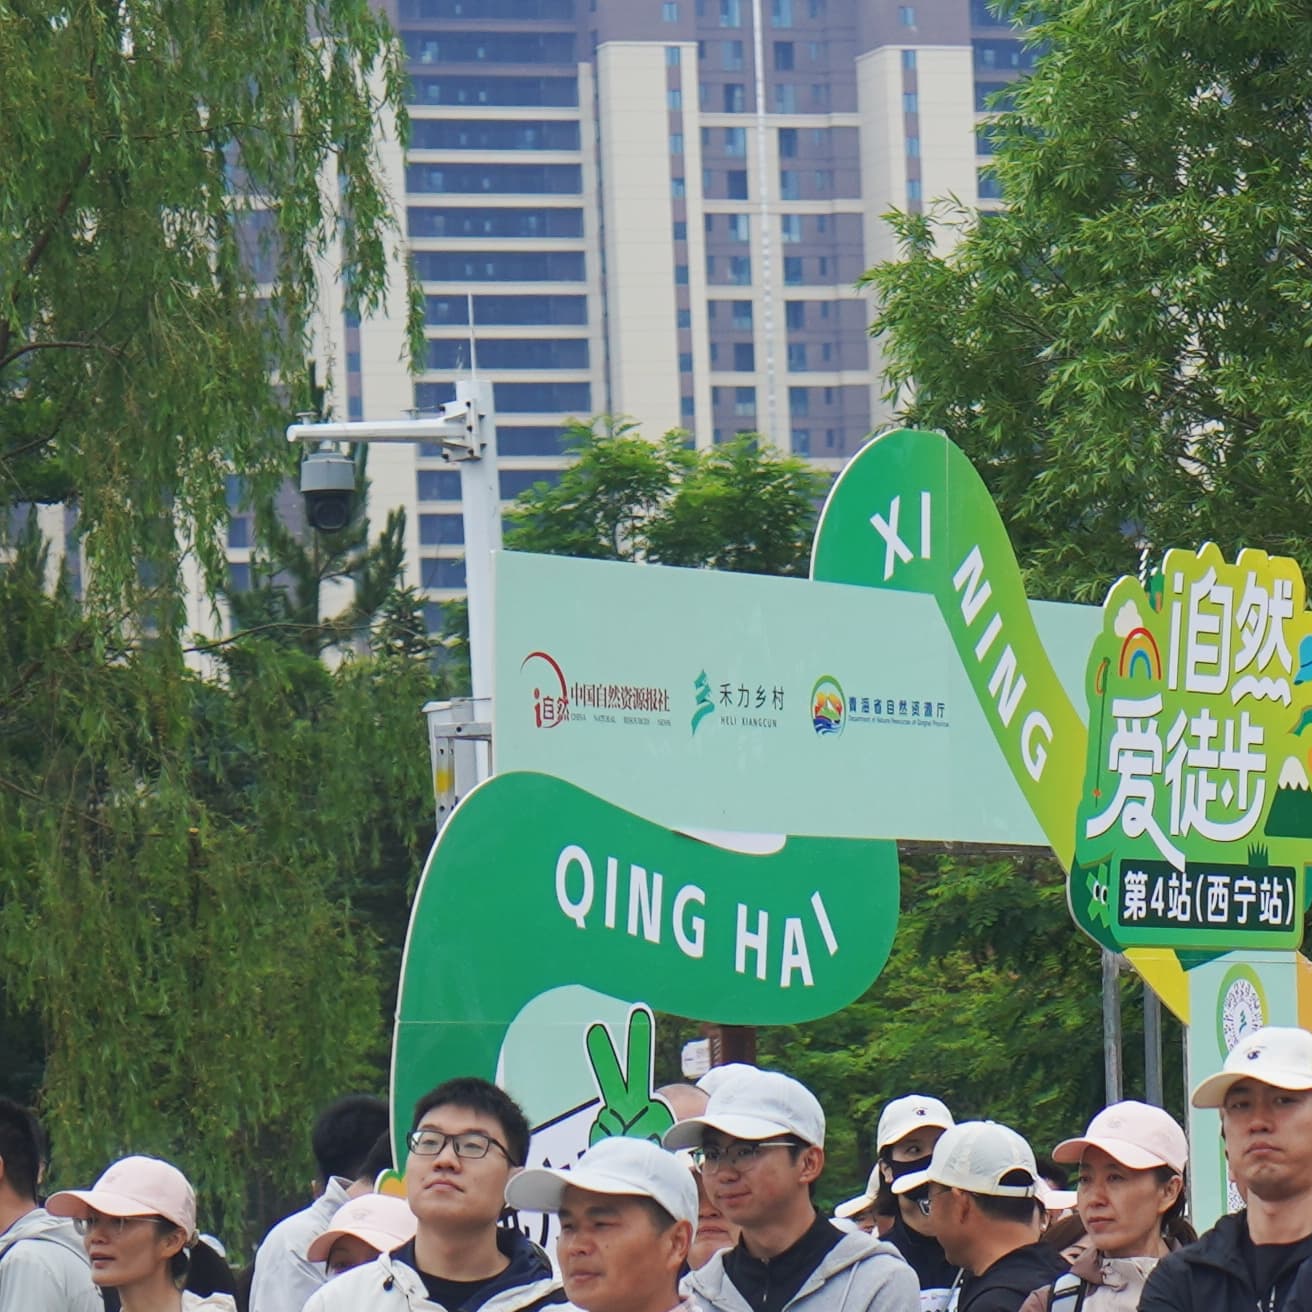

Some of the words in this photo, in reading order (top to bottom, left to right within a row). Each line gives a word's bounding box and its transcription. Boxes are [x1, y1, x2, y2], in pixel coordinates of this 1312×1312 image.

[869, 491, 931, 582] XI
[952, 544, 1054, 783] NING
[570, 682, 671, 712] 中国自然资源报社
[719, 683, 785, 712] 禾力乡村
[720, 717, 737, 726] HELI
[741, 718, 777, 729] XIANGCUN
[1086, 692, 1266, 873] 爱徒步
[555, 844, 706, 959] QING
[735, 891, 839, 988] HAI
